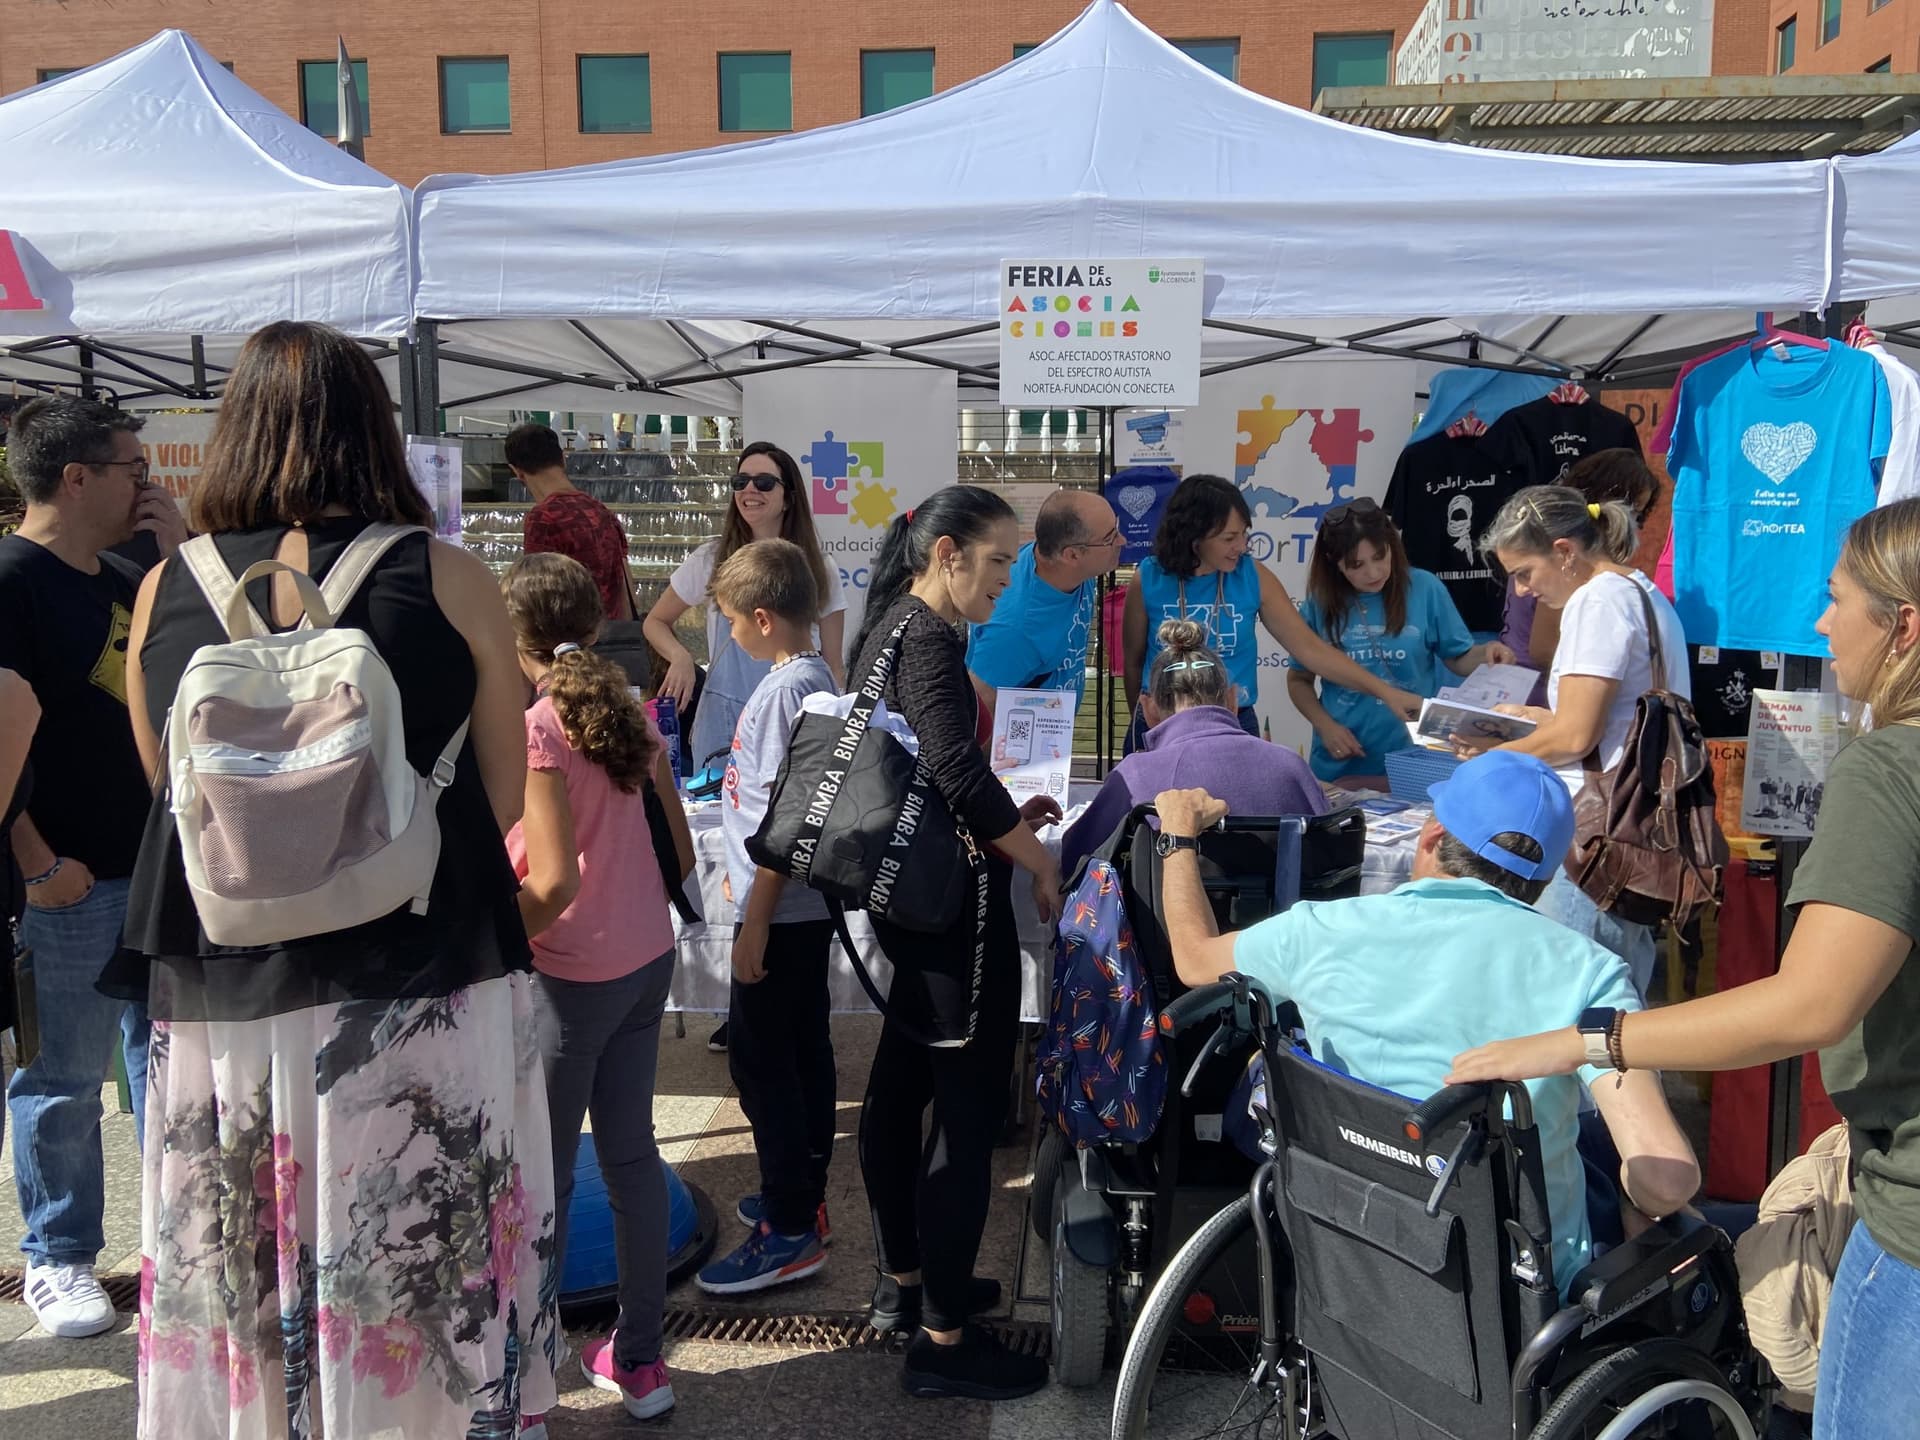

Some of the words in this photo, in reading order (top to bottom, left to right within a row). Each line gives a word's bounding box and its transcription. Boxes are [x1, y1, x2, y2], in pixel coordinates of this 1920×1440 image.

[1008, 265, 1084, 287] FERIA
[1089, 266, 1104, 275] DE
[1089, 277, 1112, 287] LAS
[1007, 294, 1141, 313] ASOCIA
[1057, 350, 1112, 361] AFECTADOS
[1114, 350, 1171, 361] TRASTORNO
[1047, 367, 1064, 377] DEL
[1067, 367, 1112, 378] ESPECTRO
[1114, 367, 1151, 378] AUTISTA
[1023, 381, 1121, 393] NORTEA-FUNDACIÓN
[1123, 383, 1175, 394] CONECTEA
[157, 443, 208, 467] VIOL
[861, 648, 896, 700] BIMBA
[1757, 711, 1770, 720] DE
[1773, 713, 1788, 721] LA
[1758, 701, 1803, 712] SEMANA
[834, 707, 871, 762] BIMBA
[1756, 722, 1812, 733] JUVENTUD
[804, 769, 844, 828] BIMBA
[889, 791, 924, 847] BIMBA
[868, 856, 901, 913] BIMBA
[977, 872, 988, 934] BIMBA
[970, 942, 985, 1003] BIMBA
[1338, 1125, 1422, 1168] VERMEIREN
[1222, 1314, 1259, 1326] Pride
